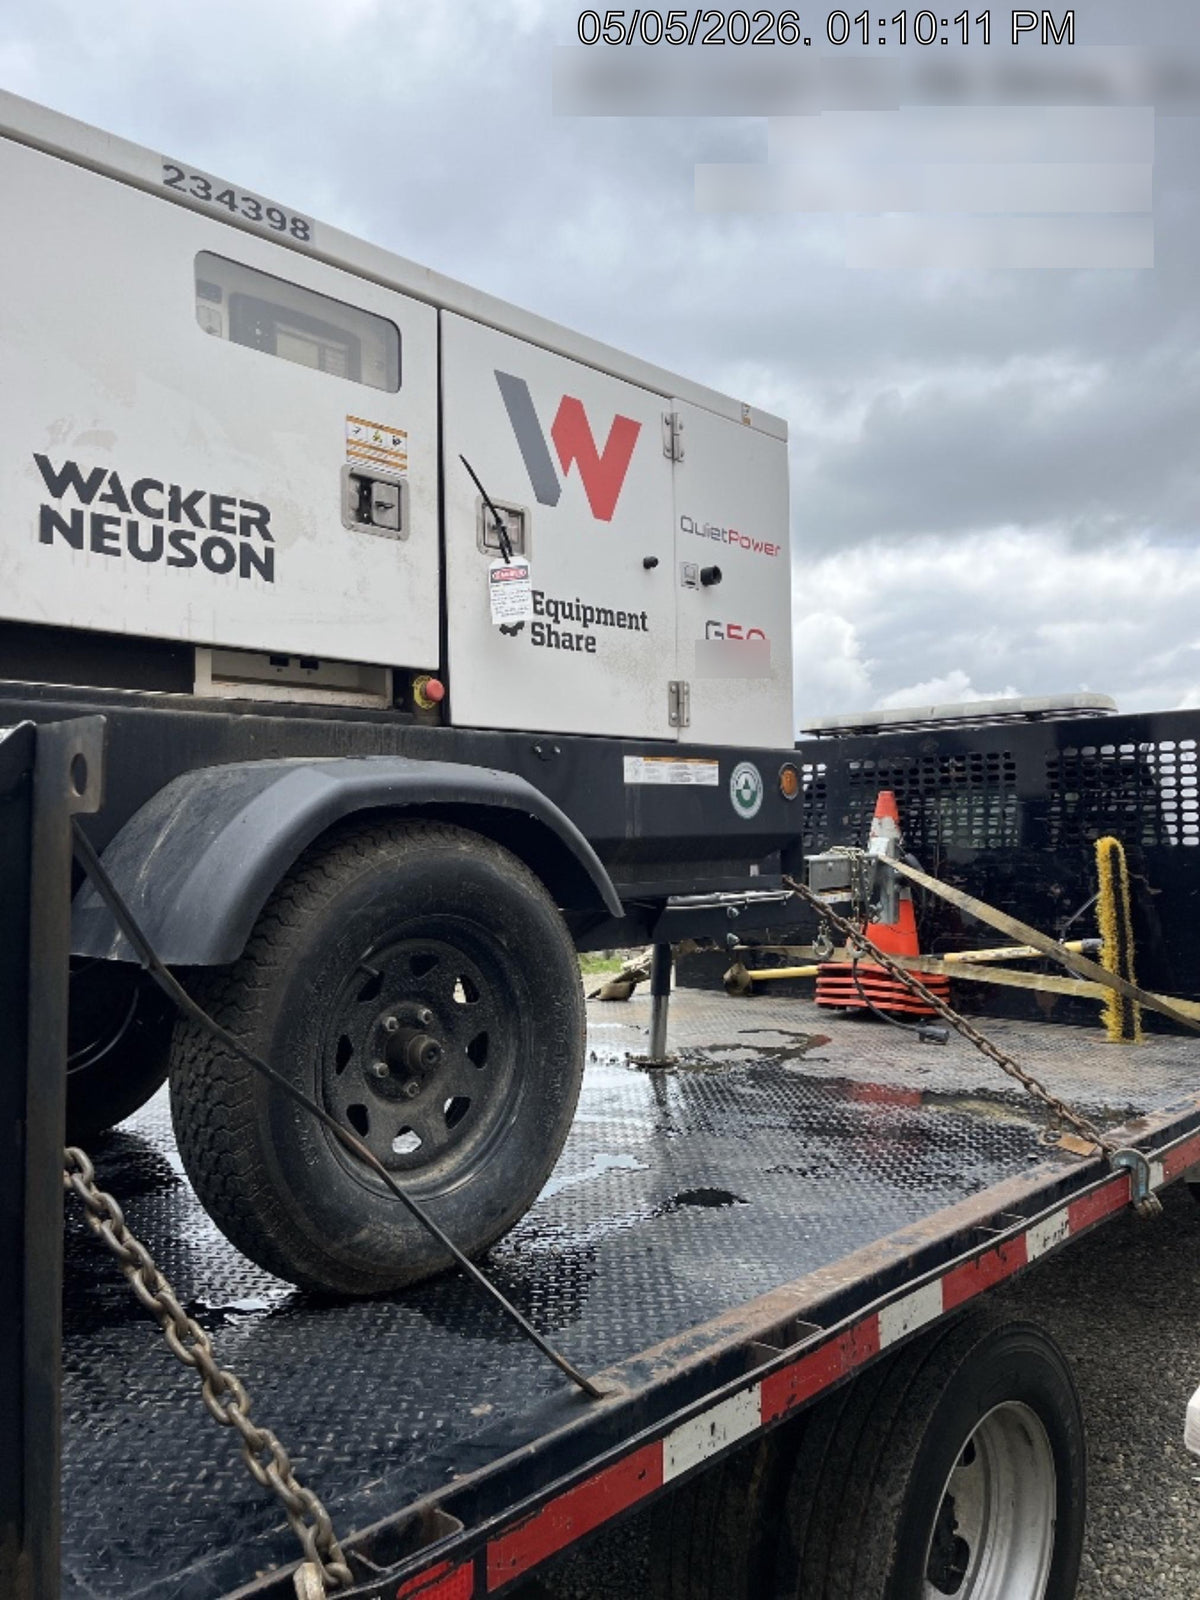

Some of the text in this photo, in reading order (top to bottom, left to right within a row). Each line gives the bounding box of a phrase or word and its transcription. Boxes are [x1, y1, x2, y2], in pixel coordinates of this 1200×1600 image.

[163, 164, 311, 242] 234398
[33, 453, 276, 543] WACKER
[39, 503, 275, 584] NEUSON
[531, 589, 649, 632] Equipment
[531, 621, 597, 653] Share
